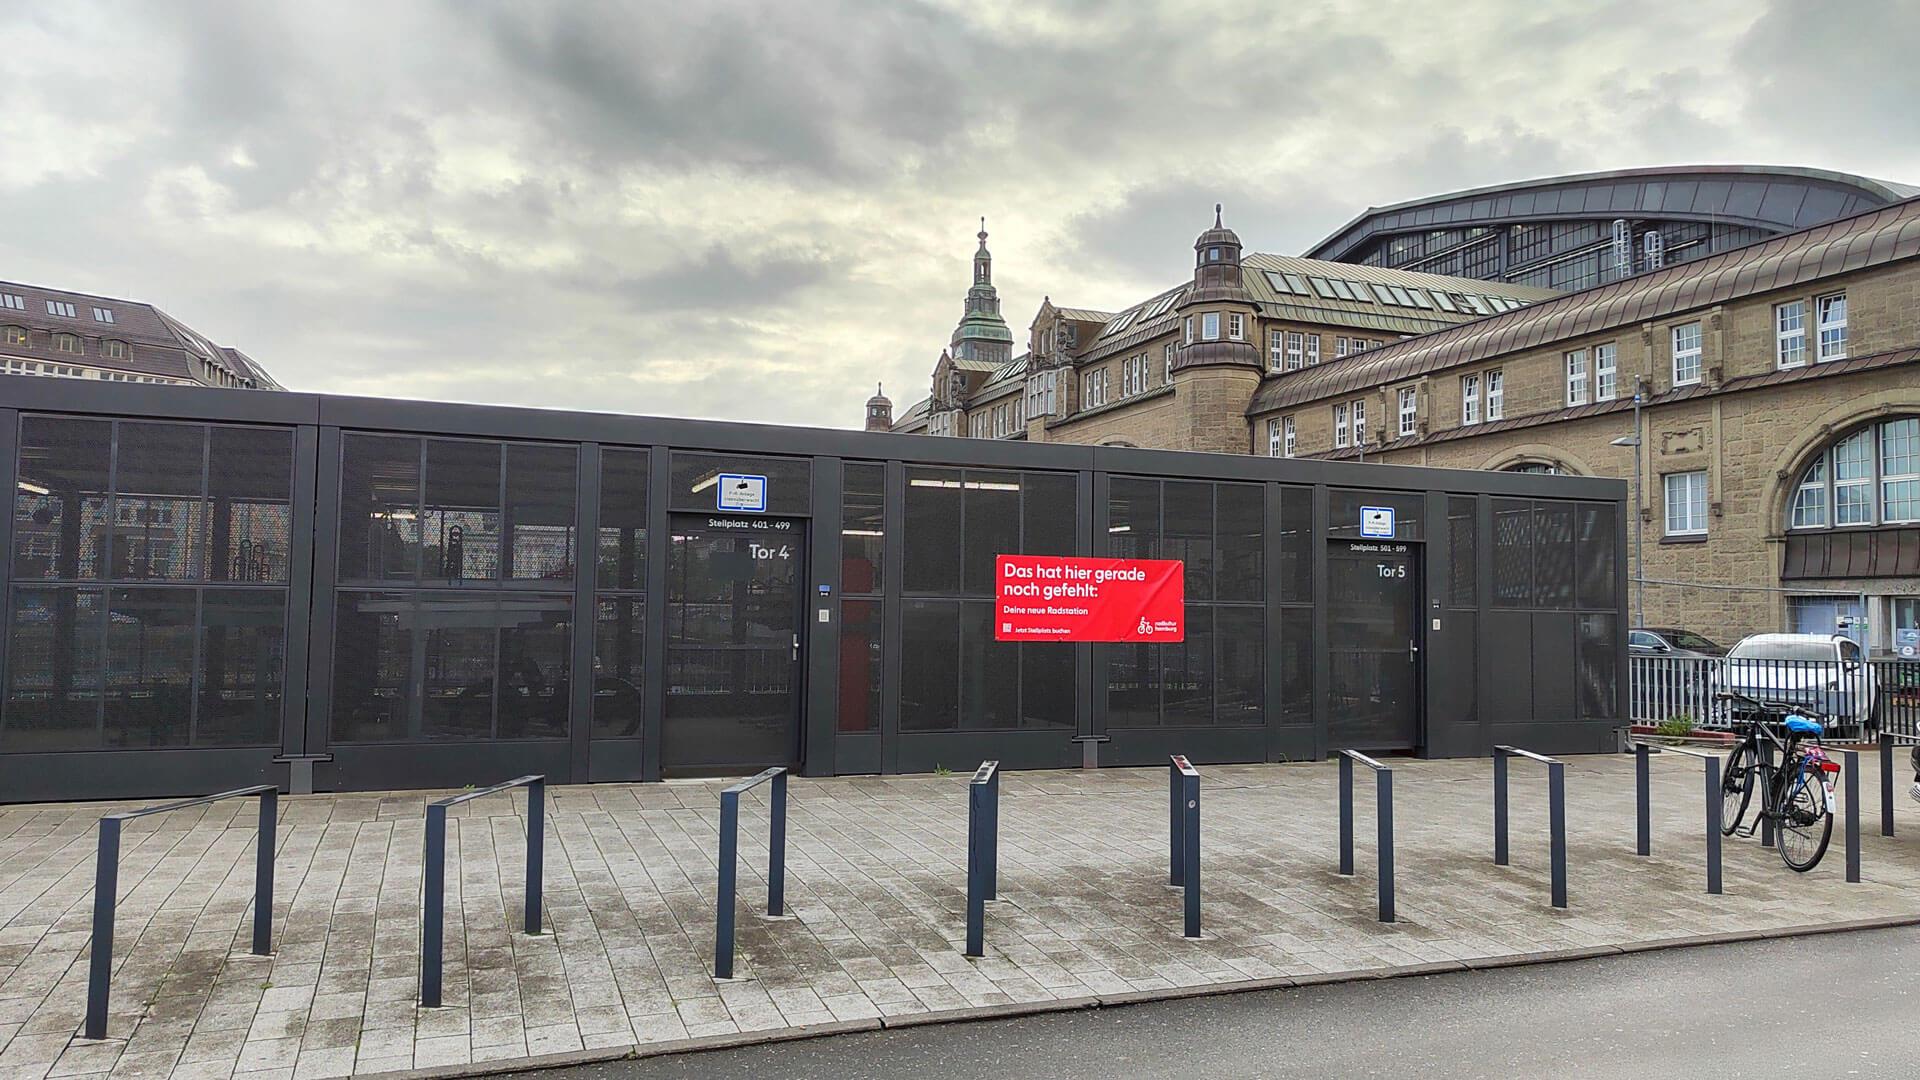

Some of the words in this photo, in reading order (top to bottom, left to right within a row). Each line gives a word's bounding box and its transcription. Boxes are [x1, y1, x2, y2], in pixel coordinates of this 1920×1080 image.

[708, 518, 749, 529] Stellplatz
[749, 544, 776, 559] Tor
[778, 545, 790, 560] 4
[1350, 543, 1379, 552] Stellplatz
[1004, 563, 1033, 579] Das
[1036, 564, 1062, 580] hat
[1065, 565, 1091, 580] hier
[1095, 567, 1146, 584] gerade
[1377, 564, 1396, 577] Tor
[1398, 565, 1406, 578] 5
[1004, 582, 1040, 597] noch
[1043, 583, 1099, 600] gefehlt:
[1003, 605, 1026, 614] Deine
[1027, 606, 1046, 615] neue
[1047, 606, 1089, 615] Radstation
